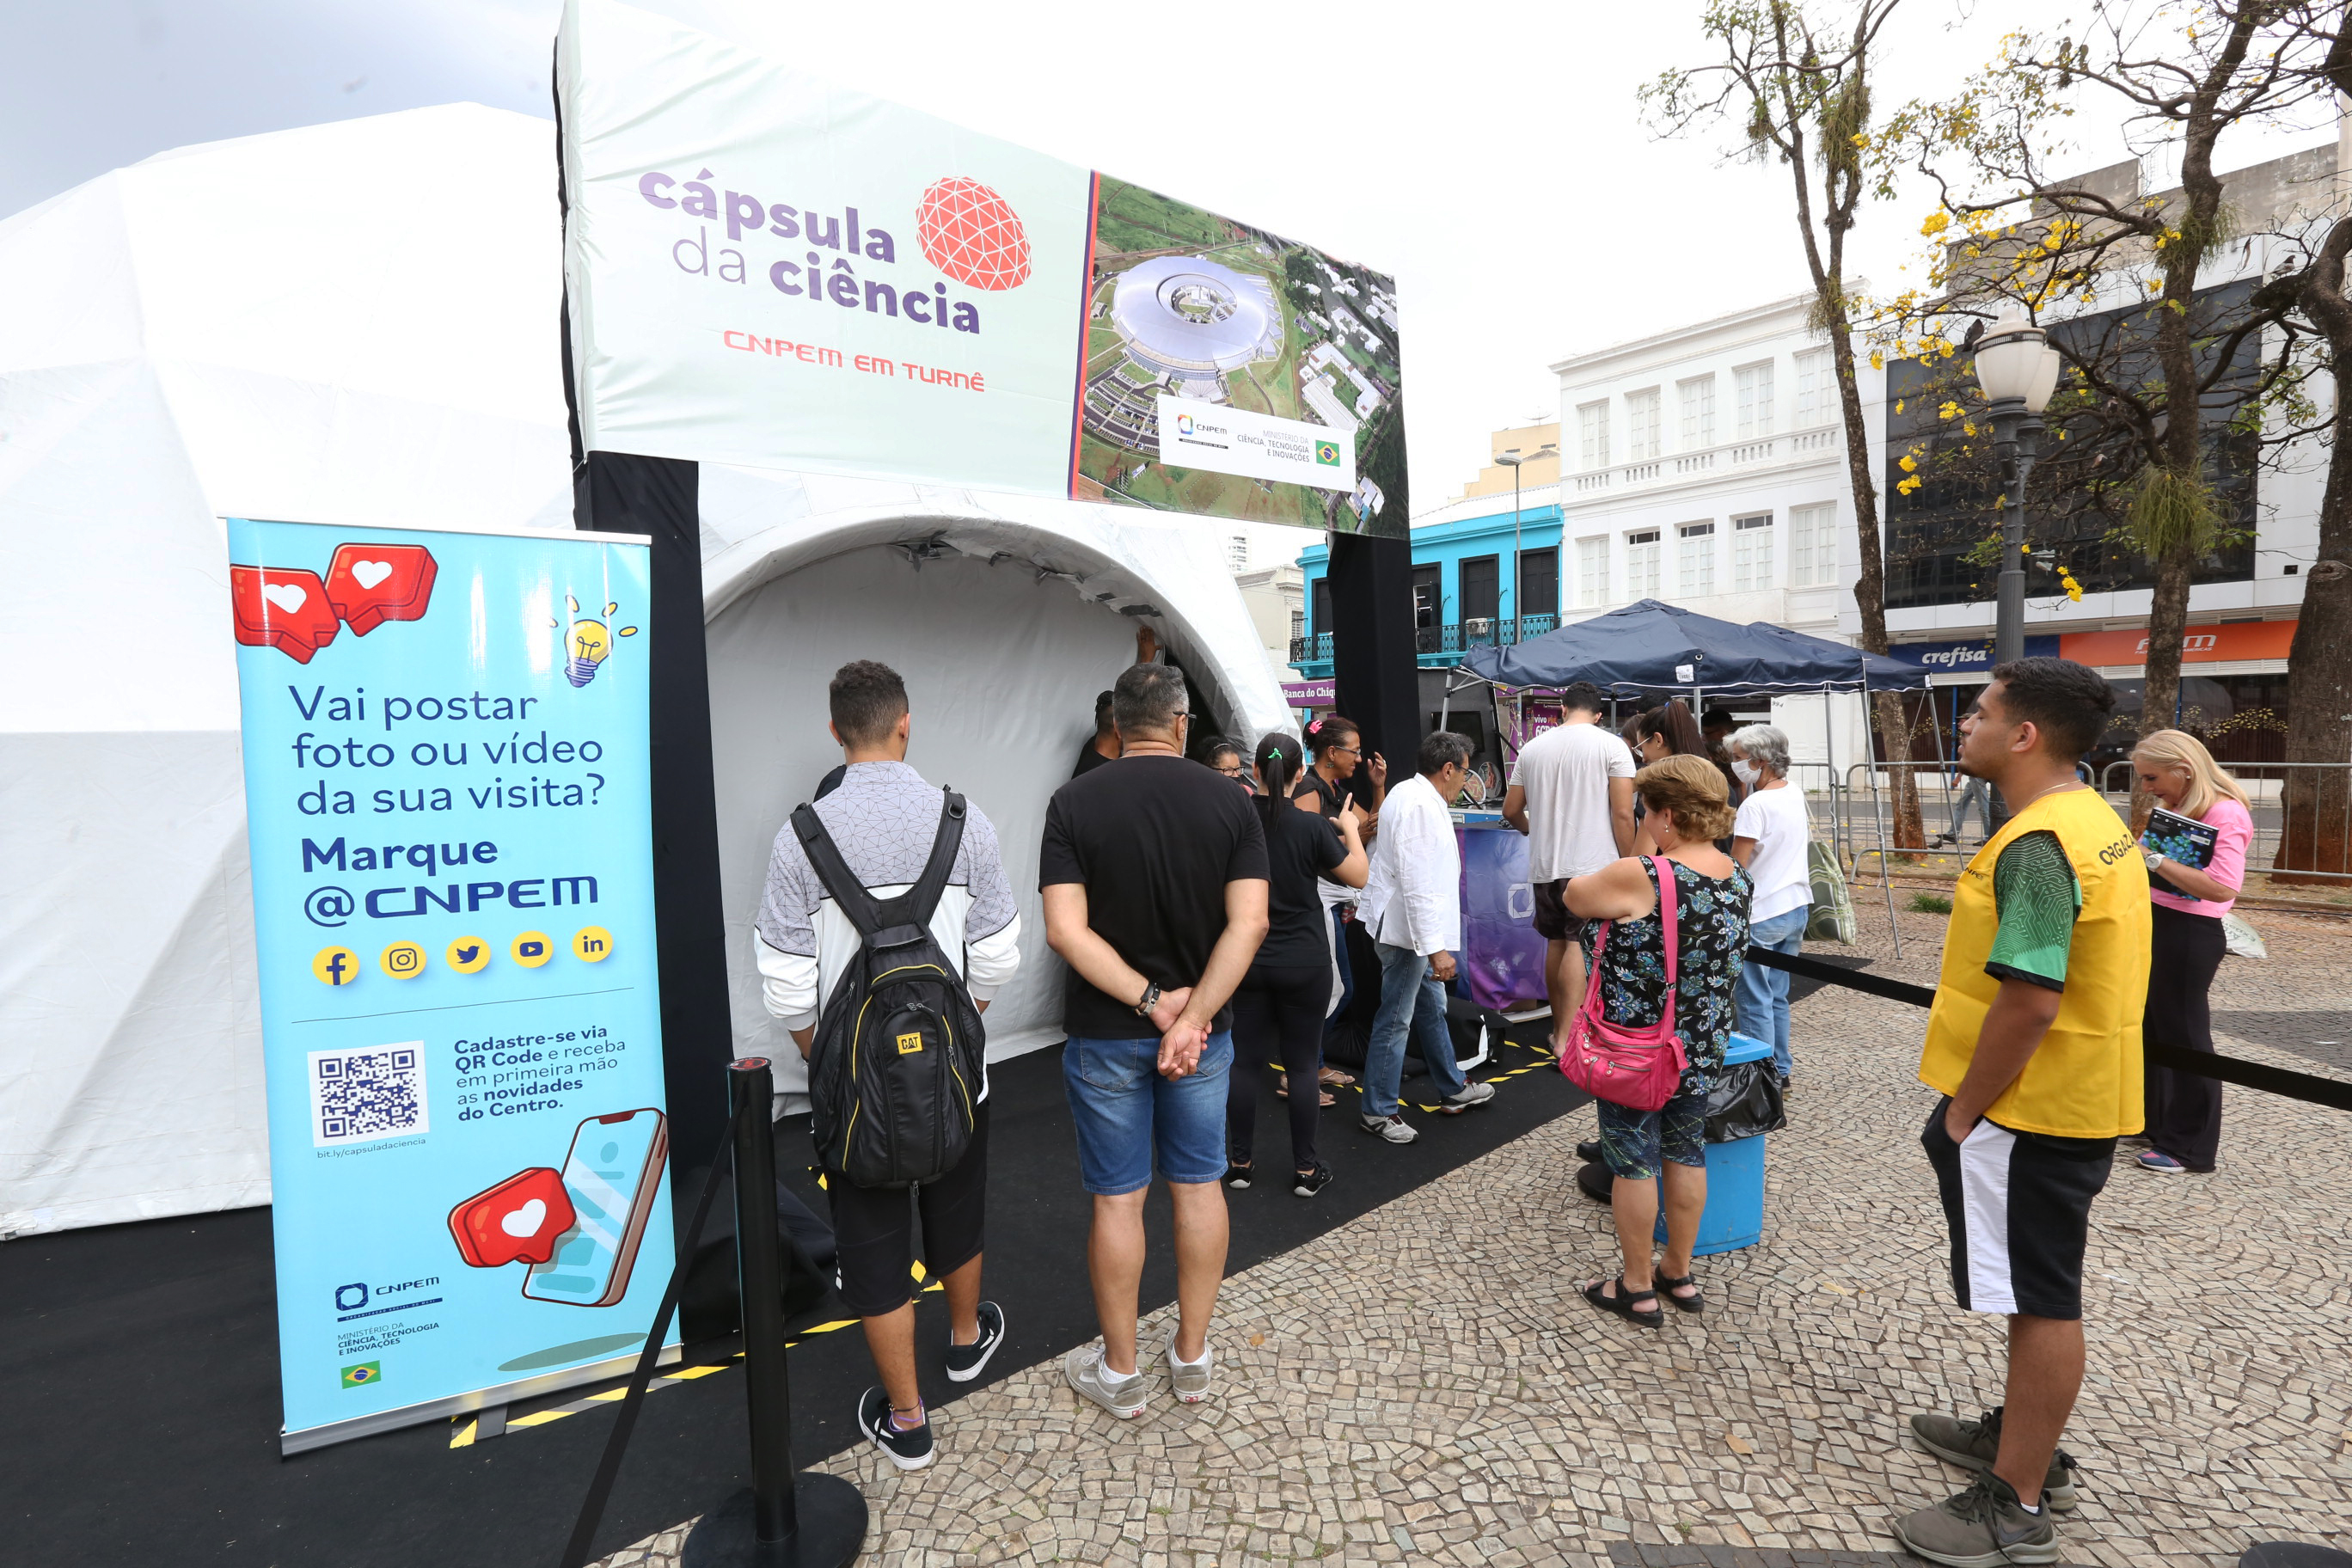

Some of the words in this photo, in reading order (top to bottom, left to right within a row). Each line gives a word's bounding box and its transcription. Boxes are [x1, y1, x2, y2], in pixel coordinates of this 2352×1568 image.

[639, 167, 896, 264] cápsula
[672, 226, 745, 285] da
[769, 257, 980, 334] ciência
[723, 330, 842, 368] CNPEM
[854, 354, 894, 377] EM
[902, 363, 985, 393] TURNÊ
[1196, 424, 1228, 435] CNPEM
[1263, 430, 1299, 443] MINISTÉRIO
[1300, 436, 1309, 444] DA
[1237, 433, 1266, 447] CIÊNCIA,
[1268, 440, 1309, 453] TECNOLOGIA
[1272, 450, 1309, 462] INOVAÇÕES
[2136, 634, 2217, 651] FM
[1921, 646, 1987, 667] crefisa
[1283, 689, 1306, 699] Banca
[1307, 688, 1315, 697] do
[288, 685, 365, 721] Vai
[384, 691, 538, 731] postar
[1534, 714, 1547, 724] vivo
[291, 732, 395, 769] foto
[410, 742, 468, 766] ou
[482, 731, 603, 764] vídeo
[297, 780, 355, 816] da
[372, 786, 453, 813] sua
[467, 773, 605, 810] visita?
[301, 836, 498, 876] Marque
[454, 1031, 577, 1055] Cadastre-se
[580, 1025, 608, 1040] via
[901, 1037, 919, 1050] CAT
[455, 1056, 487, 1075] QR
[492, 1050, 543, 1068] Code
[548, 1048, 559, 1060] e
[564, 1038, 626, 1058] receba
[456, 1075, 487, 1088] em
[493, 1063, 573, 1087] primeira
[579, 1056, 618, 1073] mão
[457, 1092, 478, 1106] as
[483, 1076, 584, 1102] novidades
[458, 1106, 484, 1122] do
[489, 1095, 564, 1117] Centro.
[317, 1138, 426, 1159] bit.ly/capsuladaciencia
[376, 1277, 439, 1295] CNPEM
[337, 1325, 389, 1341] MINISTÉRIO
[338, 1335, 378, 1349] CIÊNCIA,
[381, 1322, 439, 1339] TECNOLOGIA
[346, 1338, 401, 1354] INOVAÇÕES
